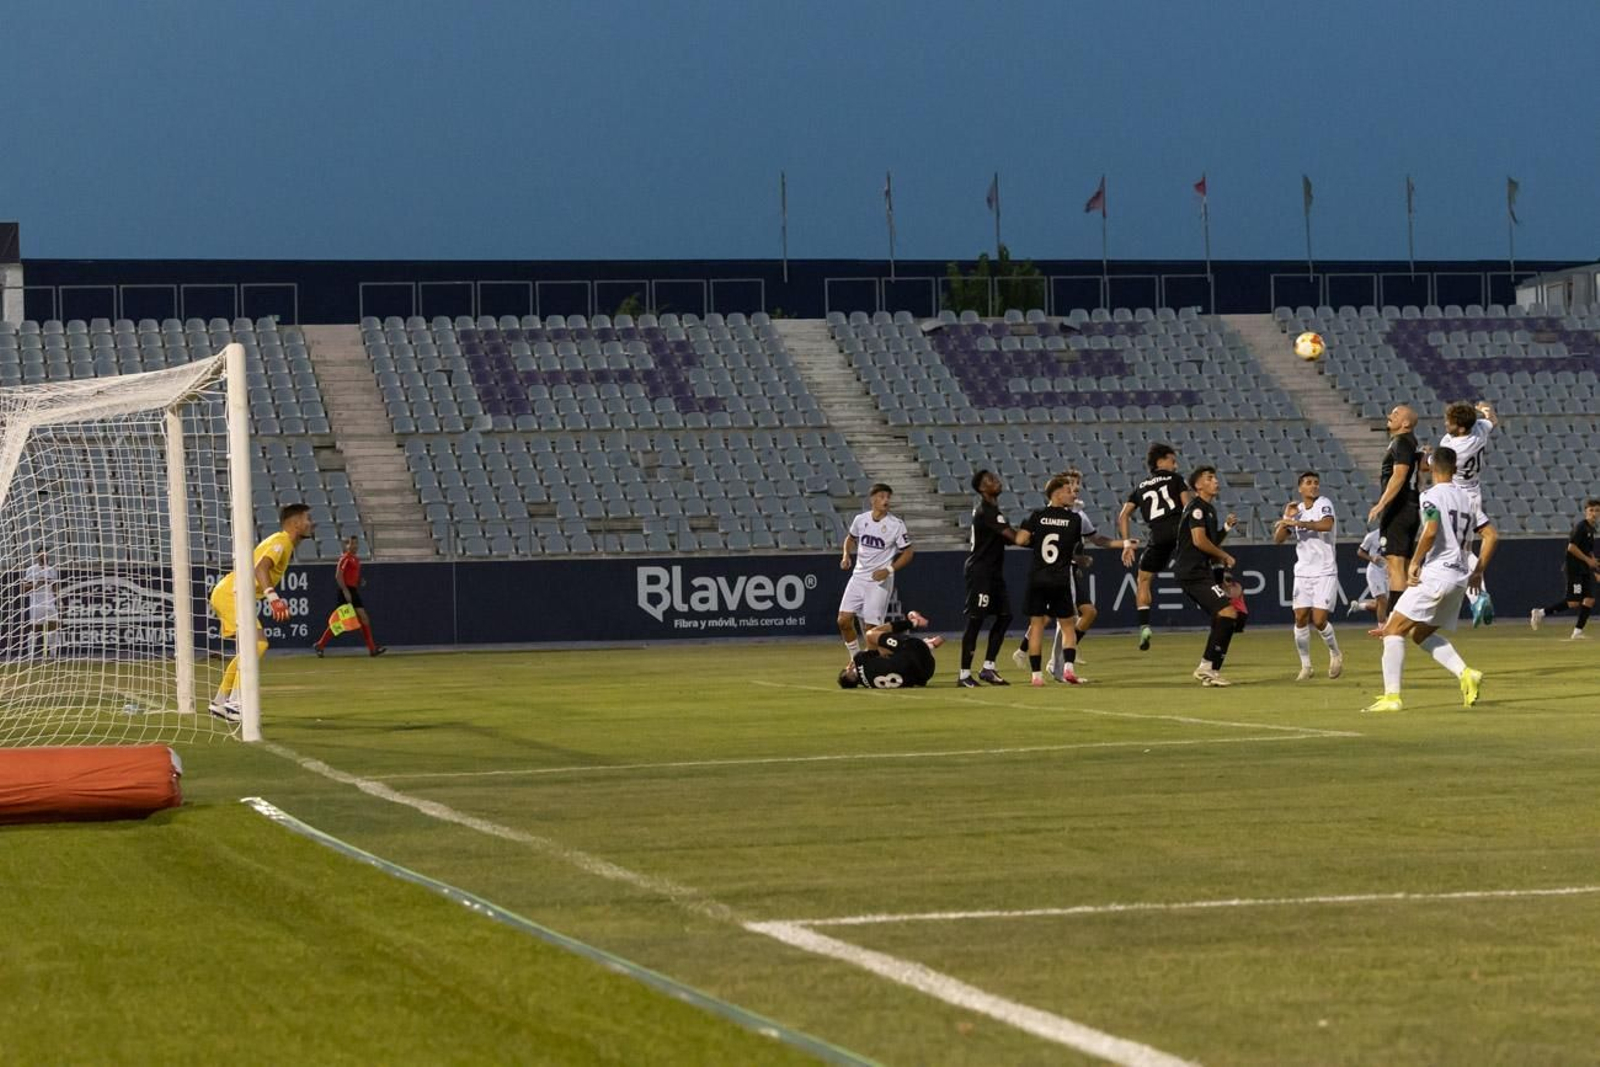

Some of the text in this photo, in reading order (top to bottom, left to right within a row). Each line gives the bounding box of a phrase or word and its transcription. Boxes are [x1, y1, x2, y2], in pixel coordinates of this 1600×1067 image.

[1142, 485, 1176, 520] 21
[1449, 509, 1472, 550] 17
[1041, 533, 1059, 564] 6
[978, 593, 990, 607] 19
[290, 623, 309, 637] 76
[674, 615, 806, 630] Fibra y móvil, más cerca de ti
[886, 637, 898, 648] 8
[873, 672, 903, 689] 8
